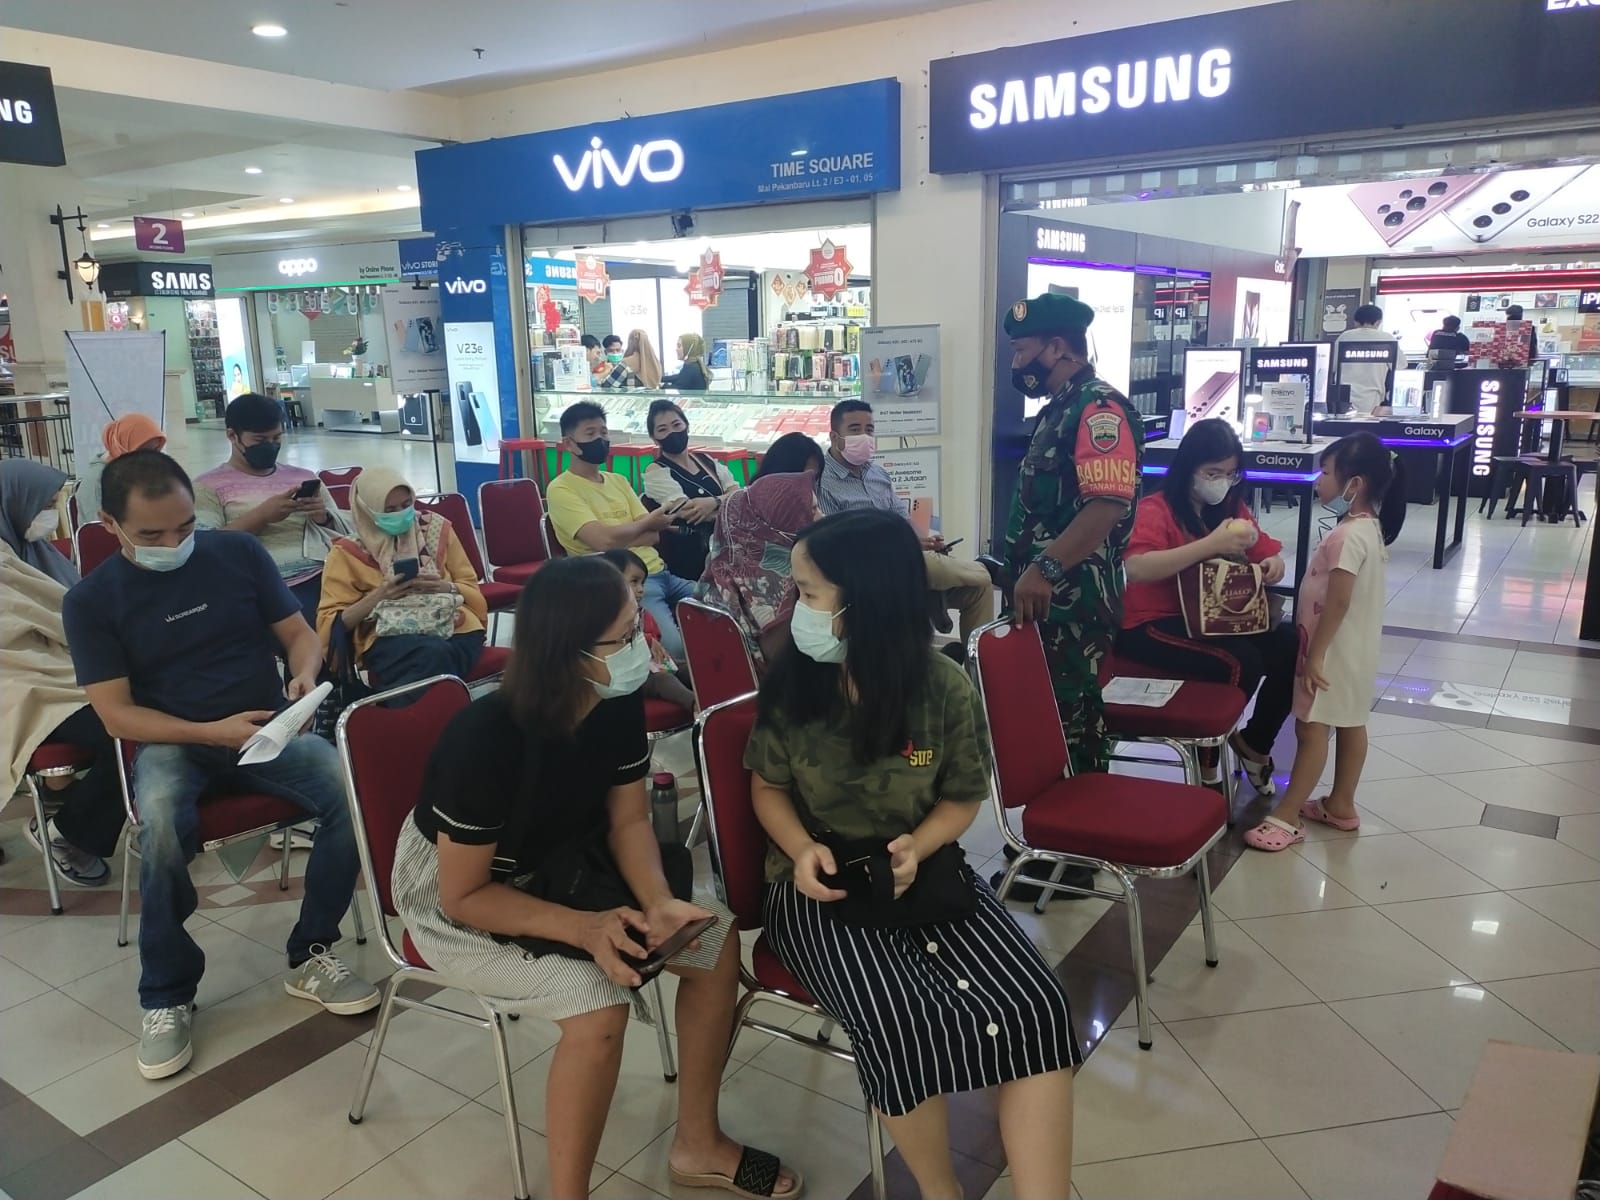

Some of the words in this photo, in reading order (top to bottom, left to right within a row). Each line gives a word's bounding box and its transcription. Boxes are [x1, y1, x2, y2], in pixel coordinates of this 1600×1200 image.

[969, 48, 1231, 129] SAMSUNG
[553, 136, 685, 191] vivo
[770, 160, 805, 178] TIME
[809, 152, 874, 174] SQUARE
[772, 181, 810, 192] Pekanbaru
[1527, 217, 1576, 228] Galaxy
[1577, 213, 1600, 224] S22
[152, 223, 169, 245] 2
[1037, 227, 1086, 253] SAMSUNG
[278, 258, 318, 277] oppo
[445, 276, 487, 294] vivo
[457, 343, 484, 354] V23e
[1345, 350, 1389, 358] SAMSUNG
[1257, 358, 1308, 368] SAMSUNG
[1404, 426, 1445, 438] Galaxy
[1472, 380, 1500, 476] SAMSUNG
[1256, 454, 1303, 468] Galaxy
